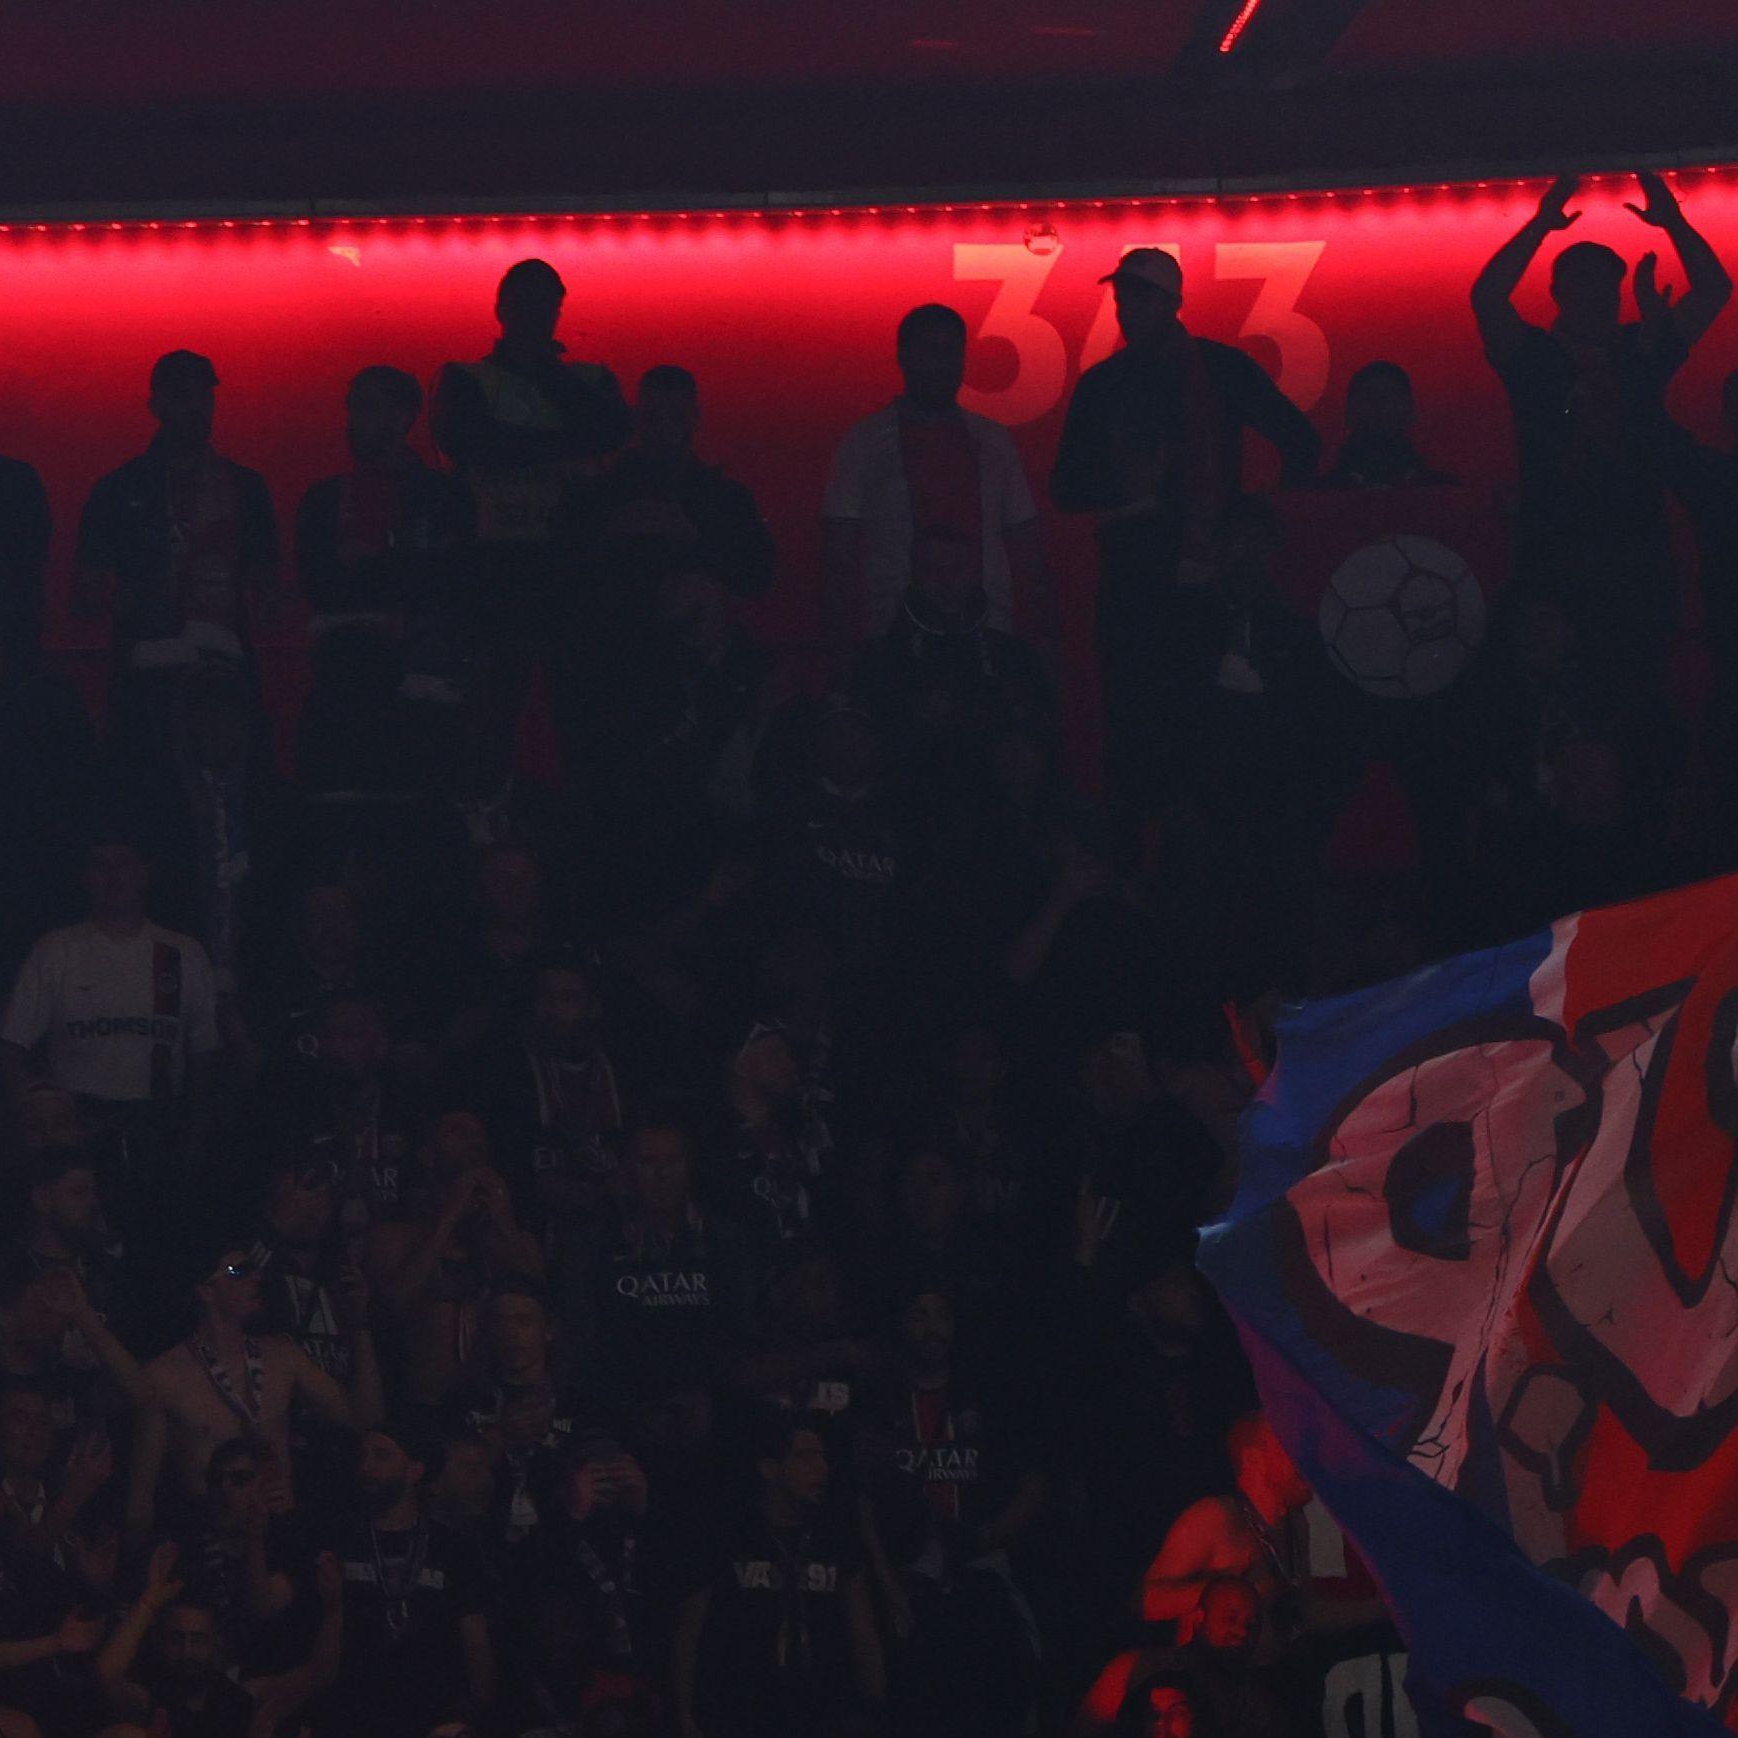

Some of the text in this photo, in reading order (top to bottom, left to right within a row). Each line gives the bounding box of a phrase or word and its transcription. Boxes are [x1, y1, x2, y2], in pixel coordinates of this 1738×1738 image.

[616, 1271, 707, 1298] QATAR
[640, 1293, 710, 1307] AIRWAYS
[895, 1447, 979, 1472] QATAR
